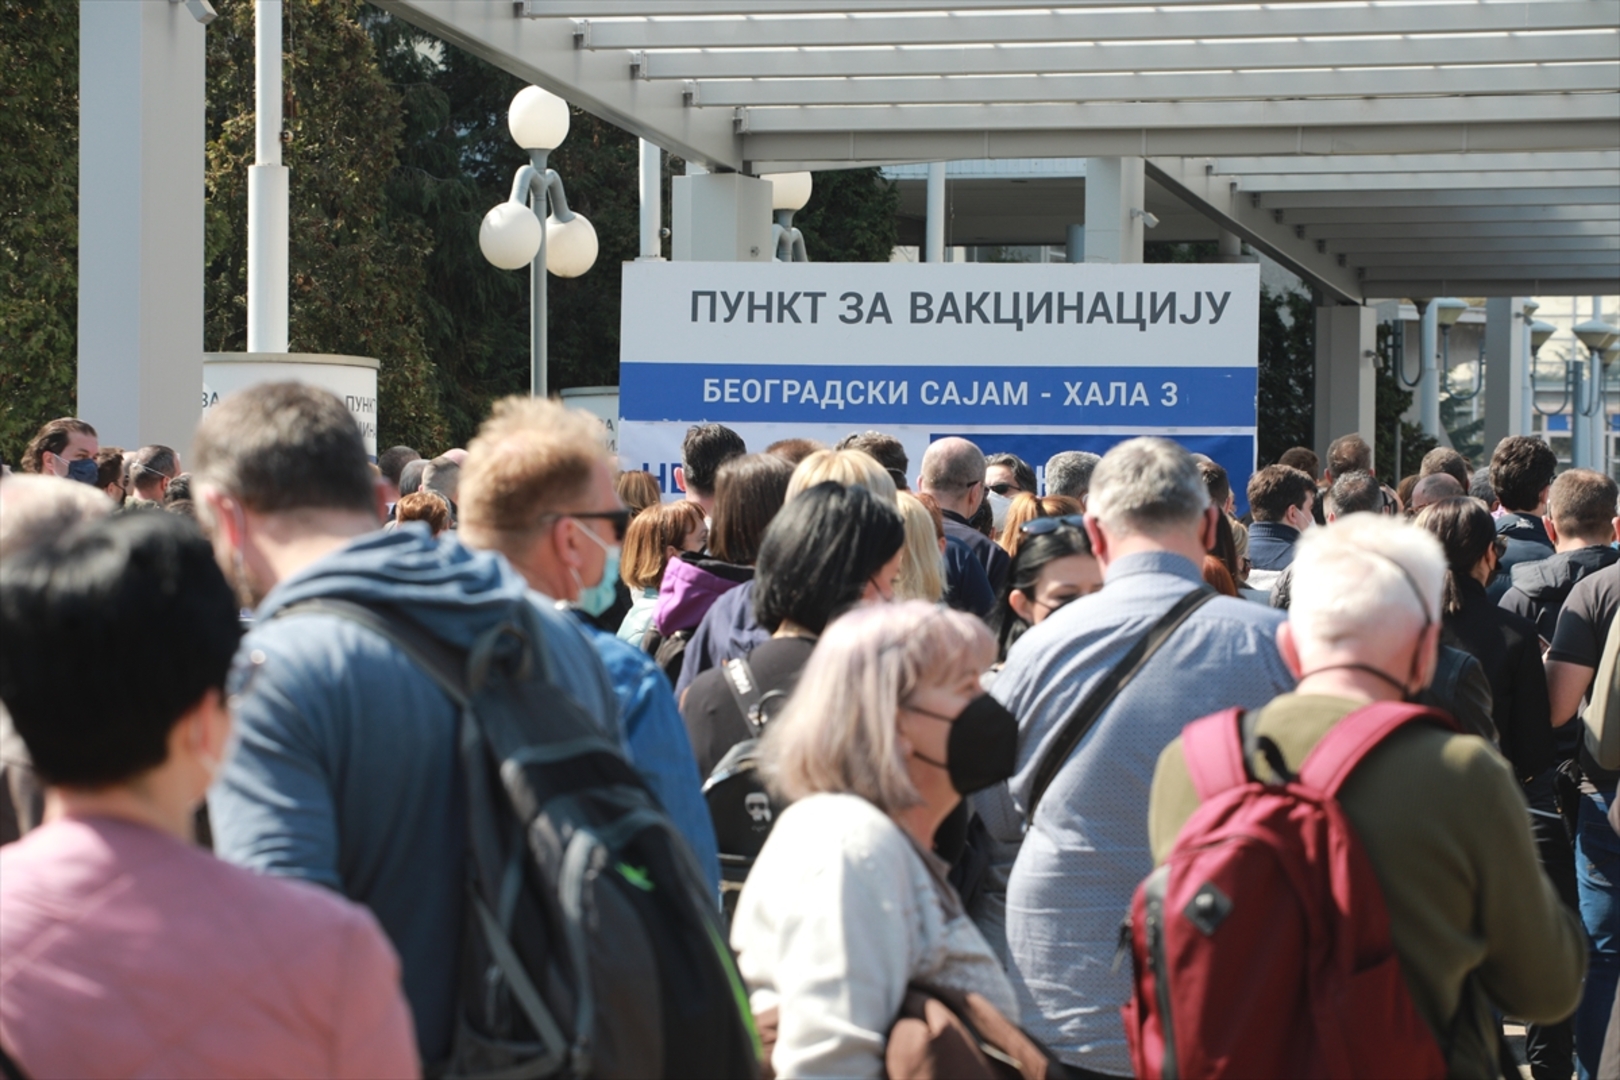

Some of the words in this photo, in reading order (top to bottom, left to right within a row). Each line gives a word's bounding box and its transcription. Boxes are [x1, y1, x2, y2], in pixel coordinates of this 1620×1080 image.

[690, 290, 827, 324] ПУНКТ
[838, 291, 893, 325] ЗА
[909, 290, 1232, 332] ВАКЦИНАЦИЈУ
[702, 378, 908, 410] БЕОГРАДСКИ
[920, 380, 1028, 406] САЈАМ
[1063, 381, 1150, 406] ХАЛА
[1160, 382, 1178, 407] 3
